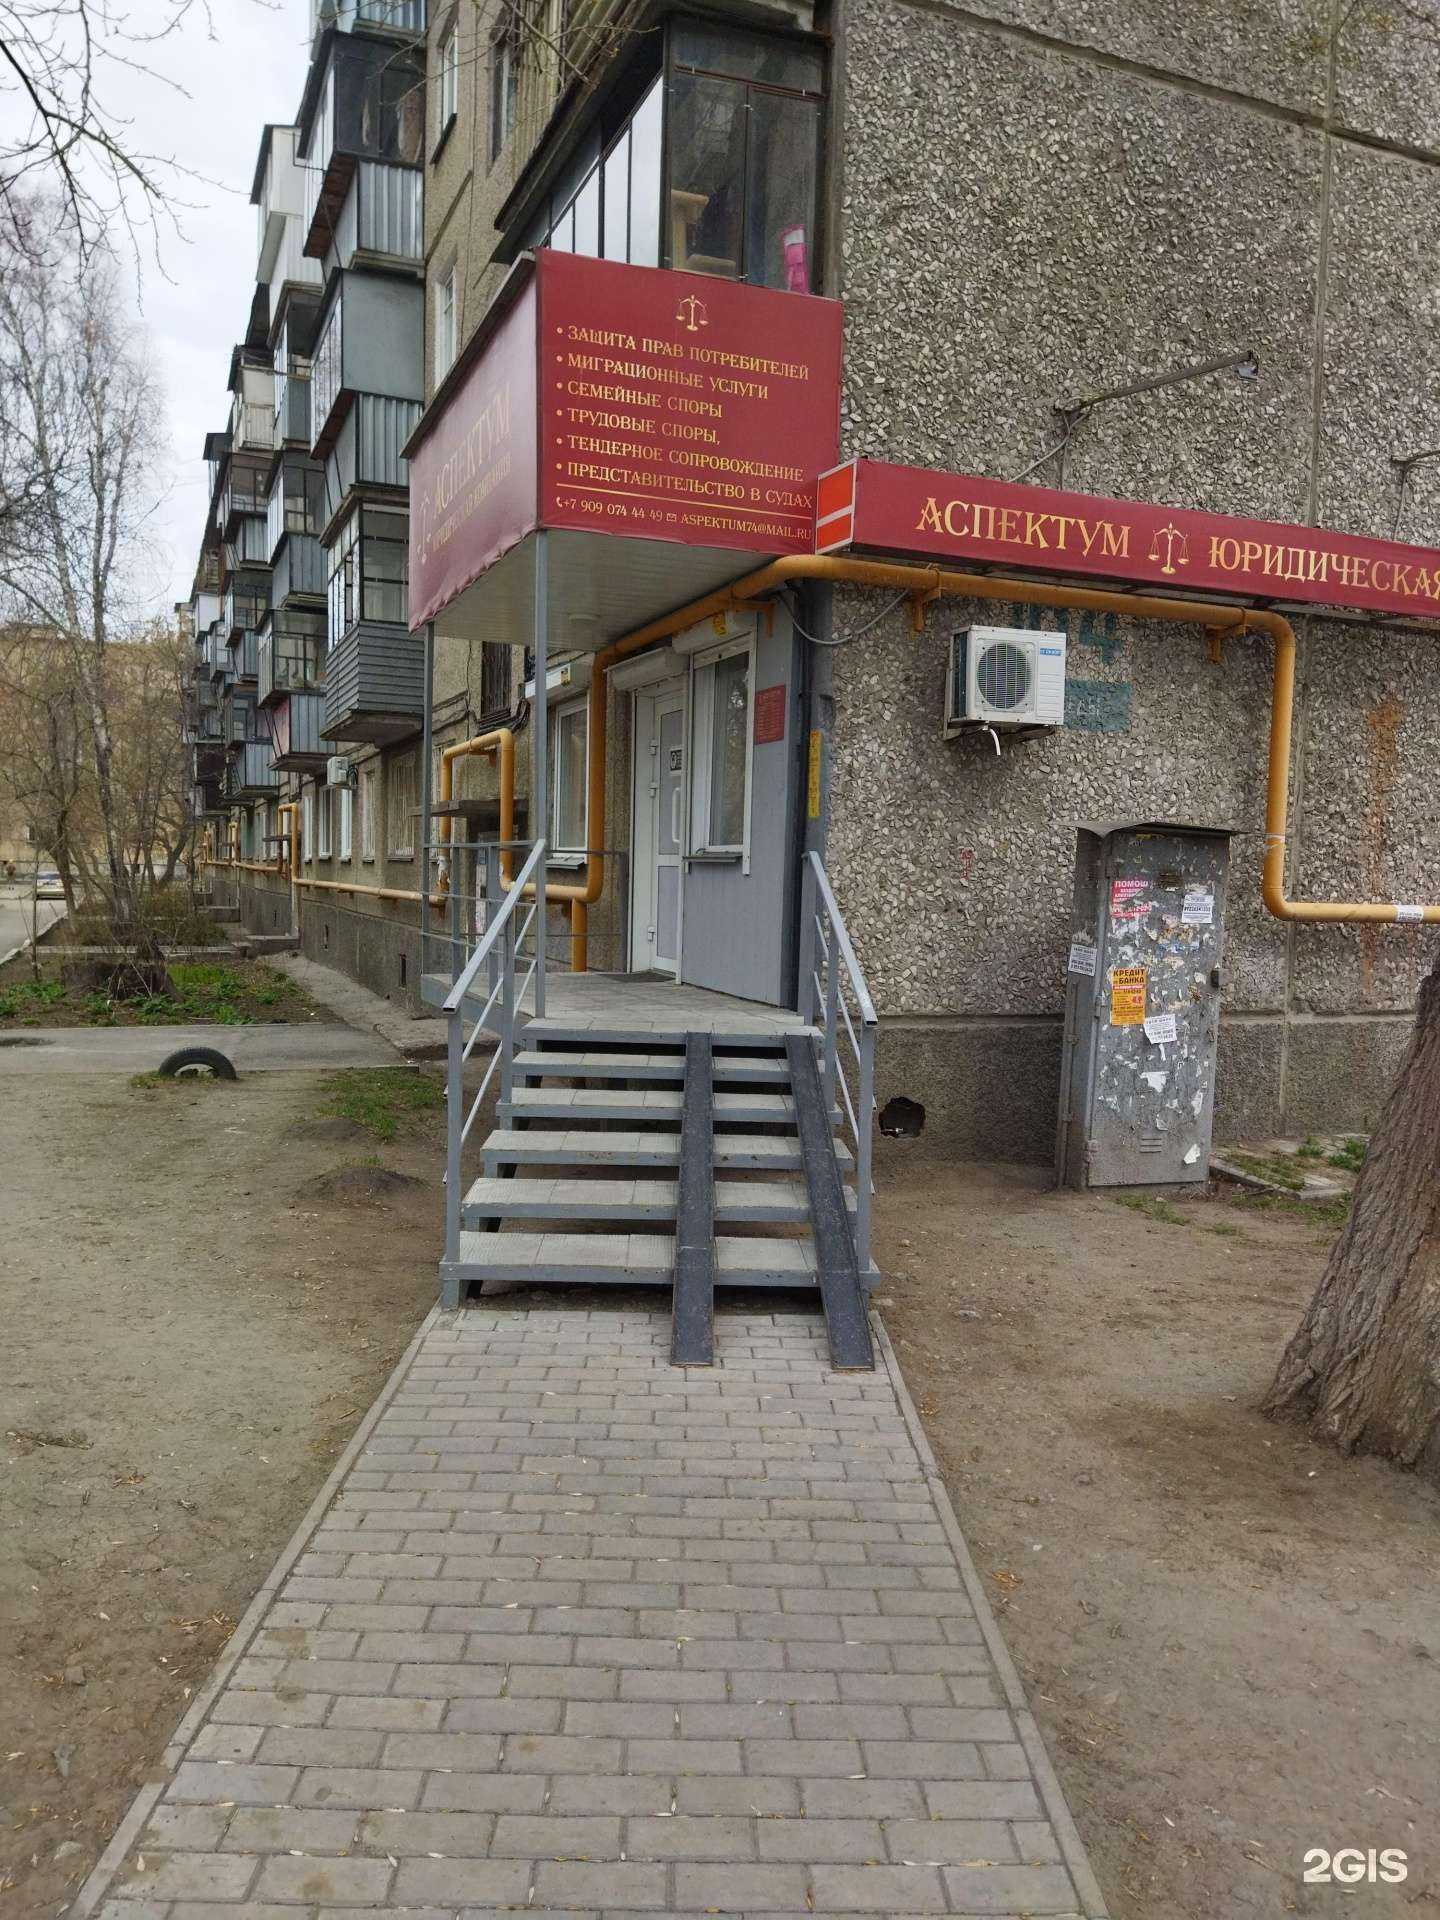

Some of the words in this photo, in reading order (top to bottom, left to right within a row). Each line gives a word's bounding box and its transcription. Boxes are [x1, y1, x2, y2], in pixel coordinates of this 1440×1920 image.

[568, 325, 636, 350] ЗАЩИТА
[641, 338, 684, 358] ПРАВ
[689, 346, 809, 380] ПОТРЕБИТЕЛЕЙ
[567, 352, 704, 388] МИГРАЦИОННЫЕ
[709, 377, 769, 399] УСЛУГИ
[567, 380, 662, 408] СЕМЕЙНЫЕ
[667, 396, 723, 418] СПОРЫ
[567, 407, 656, 434] ТРУДОВЫЕ
[661, 422, 721, 445] СПОРЫ,
[567, 434, 663, 461] ТЕНДЕРНОЕ
[668, 449, 804, 482] СОПРОВОЖДЕНИЕ
[567, 461, 745, 499] ПРЕДСТАВИТЕЛЬСТВО
[750, 487, 761, 501] В
[765, 489, 813, 508] СУДАХ
[563, 498, 577, 510] +7
[580, 499, 603, 514] 909
[607, 503, 628, 517] 074
[631, 506, 645, 519] 44
[649, 509, 663, 522] 49
[681, 513, 812, 540] ASPEKTUM74@MAIL.RU
[914, 497, 1131, 558] АСПЕКТУМ
[1113, 968, 1145, 977] КРЕДИТ
[1119, 977, 1145, 985] БАНКА
